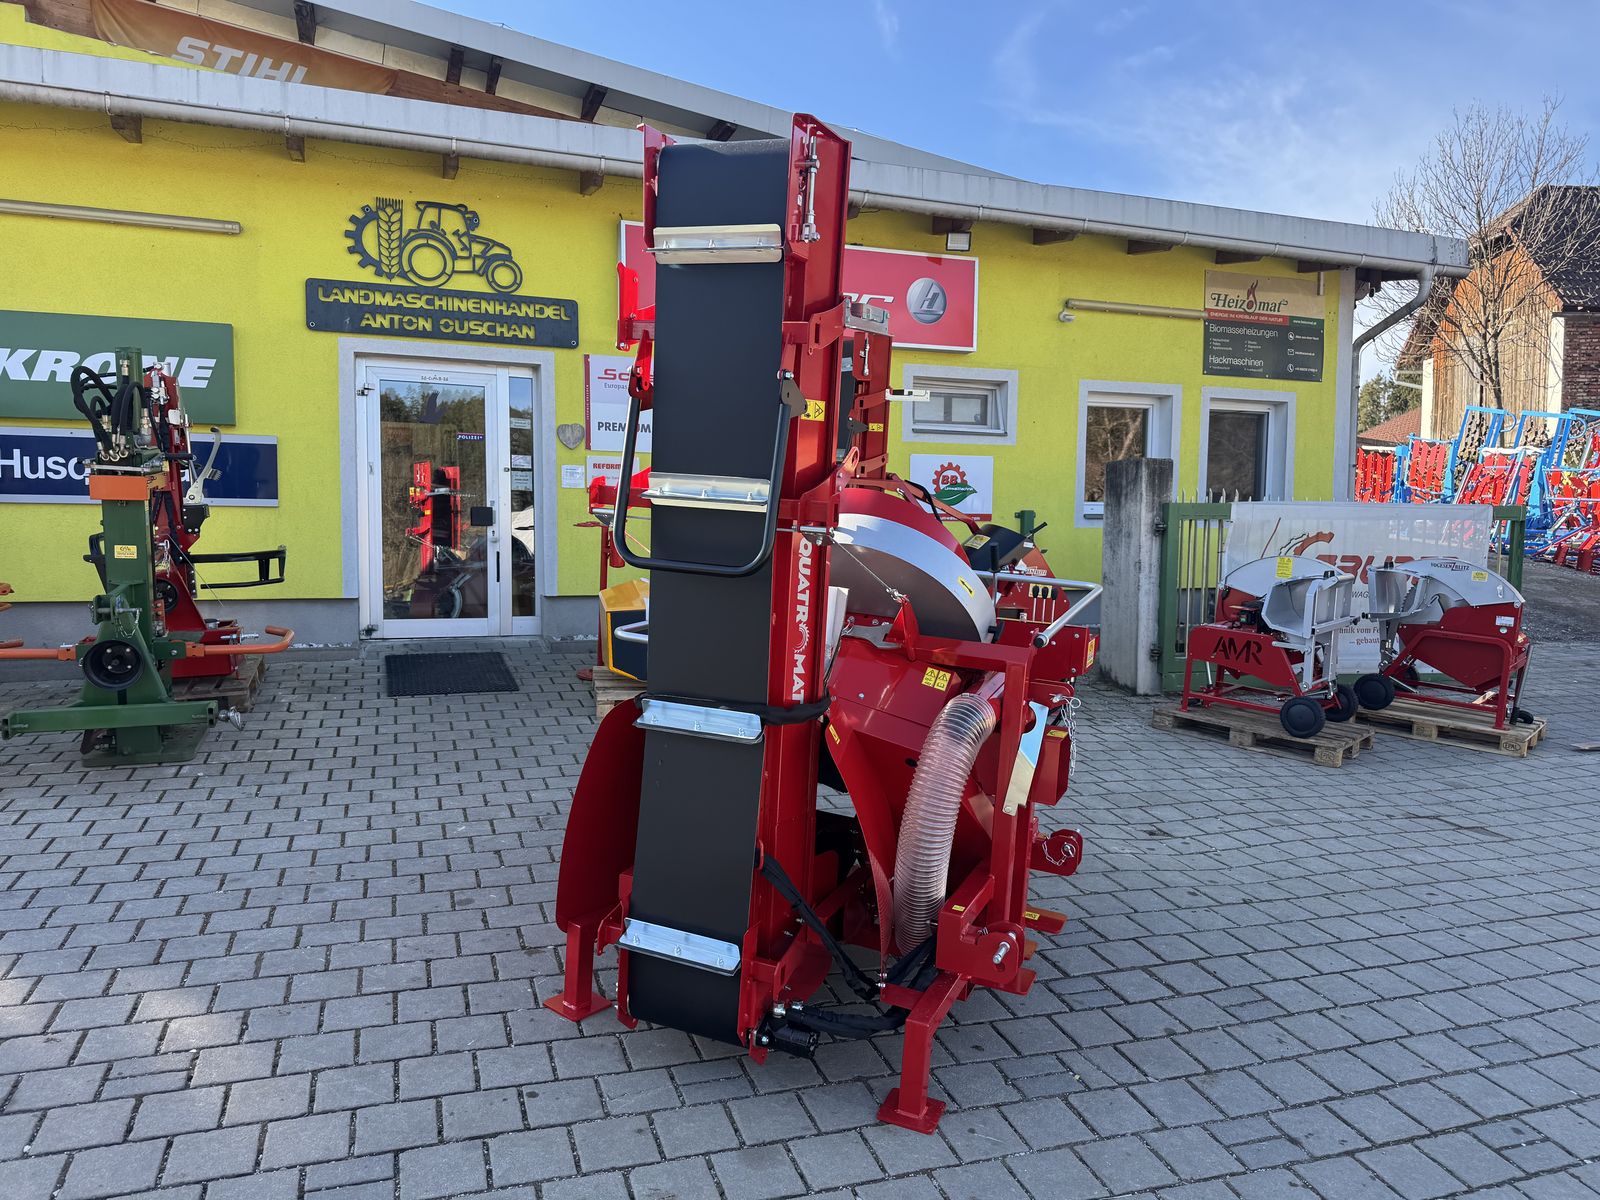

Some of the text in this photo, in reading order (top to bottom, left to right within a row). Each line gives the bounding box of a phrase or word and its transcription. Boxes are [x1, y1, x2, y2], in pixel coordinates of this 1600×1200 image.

[317, 285, 571, 321] LANDMASCHINENHANDEL
[360, 312, 536, 340] ANTON OUSCHAN
[1209, 324, 1279, 339] Biomasseheizungen
[1209, 354, 1264, 367] Hackmaschinen
[597, 421, 652, 434] PREMM
[941, 475, 958, 485] BB
[1212, 636, 1263, 666] AMR
